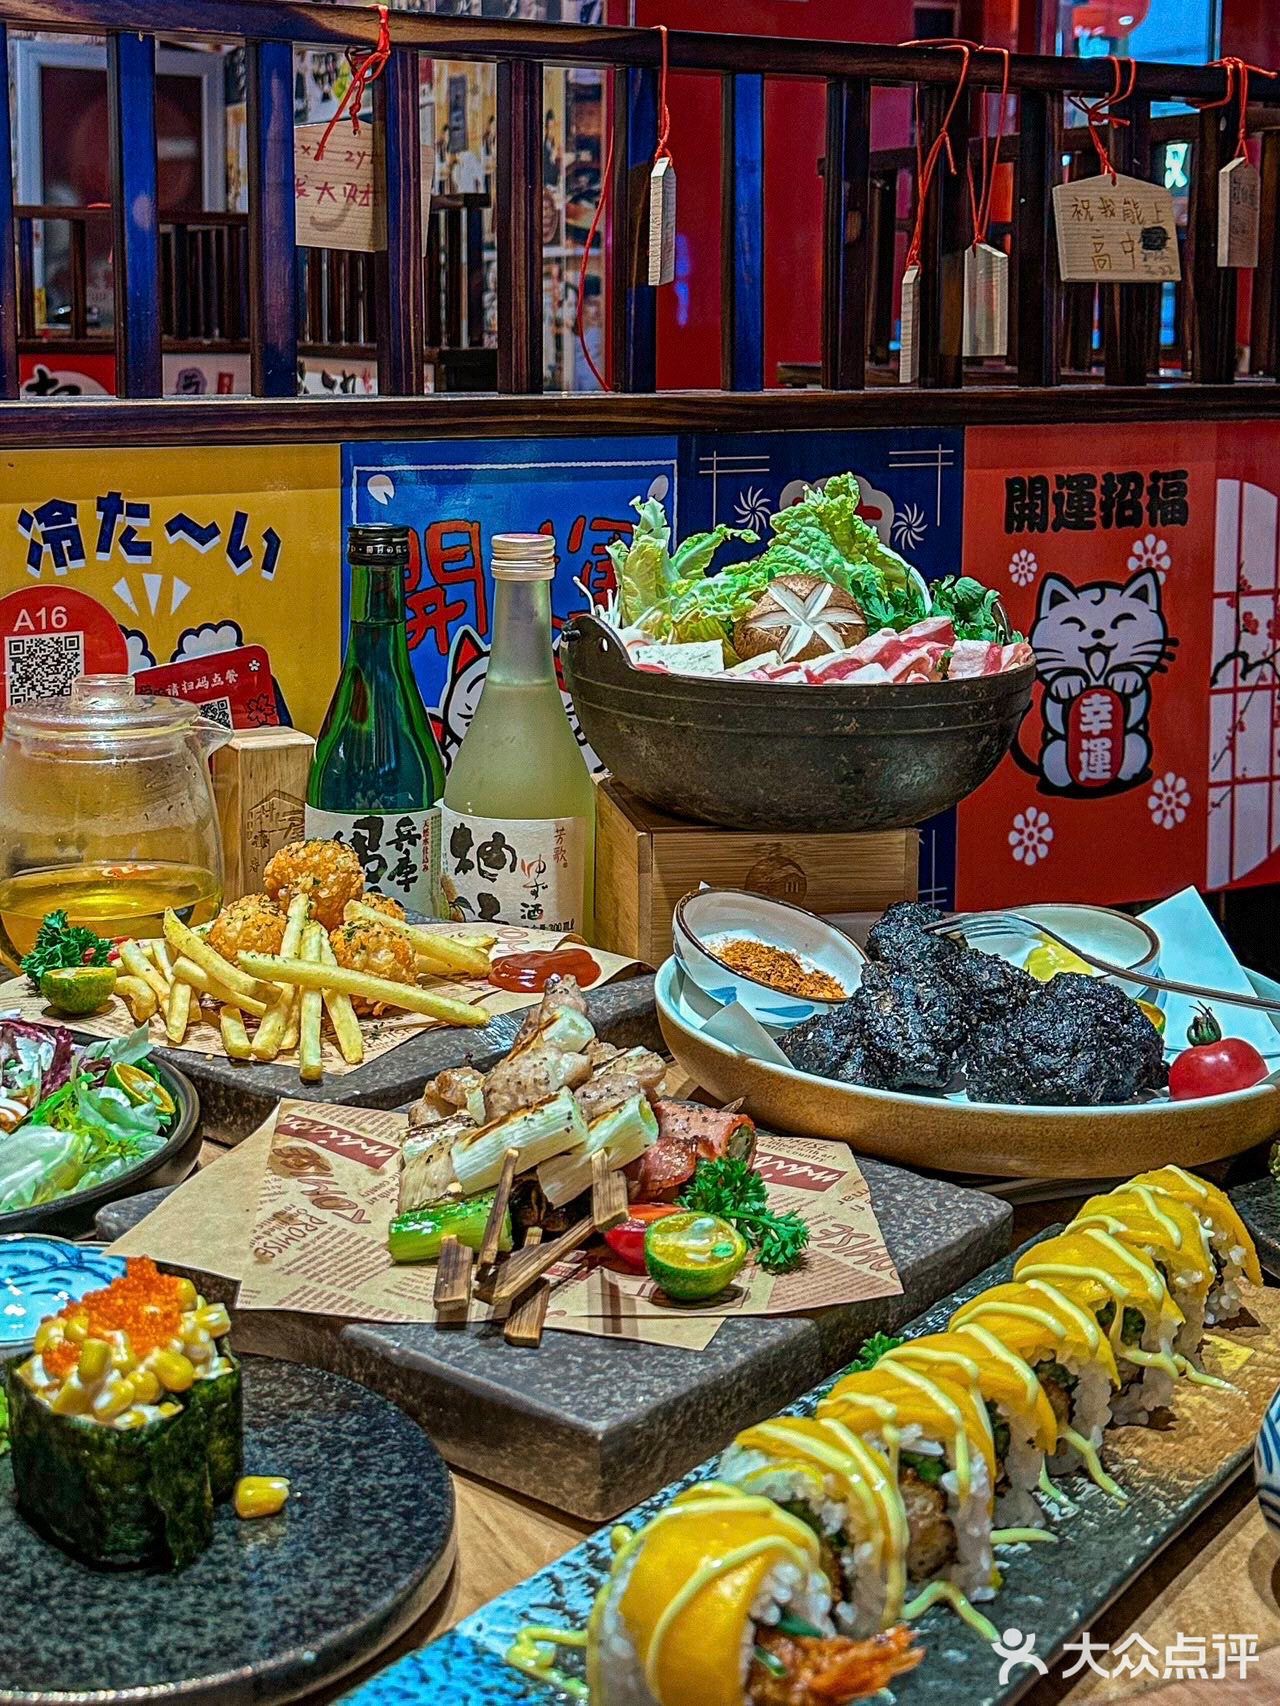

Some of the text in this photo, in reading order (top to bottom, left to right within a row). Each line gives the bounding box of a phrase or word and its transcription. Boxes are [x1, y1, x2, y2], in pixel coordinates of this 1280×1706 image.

[1071, 196, 1166, 226] 祝我能上
[1090, 229, 1137, 274] 高中
[1003, 469, 1190, 534] 開運招福
[13, 606, 68, 633] A16
[165, 670, 240, 697] 请扫码点餐
[1078, 692, 1113, 783] 幸運
[386, 816, 422, 893] 兵庫
[253, 1213, 328, 1260] PROMISE
